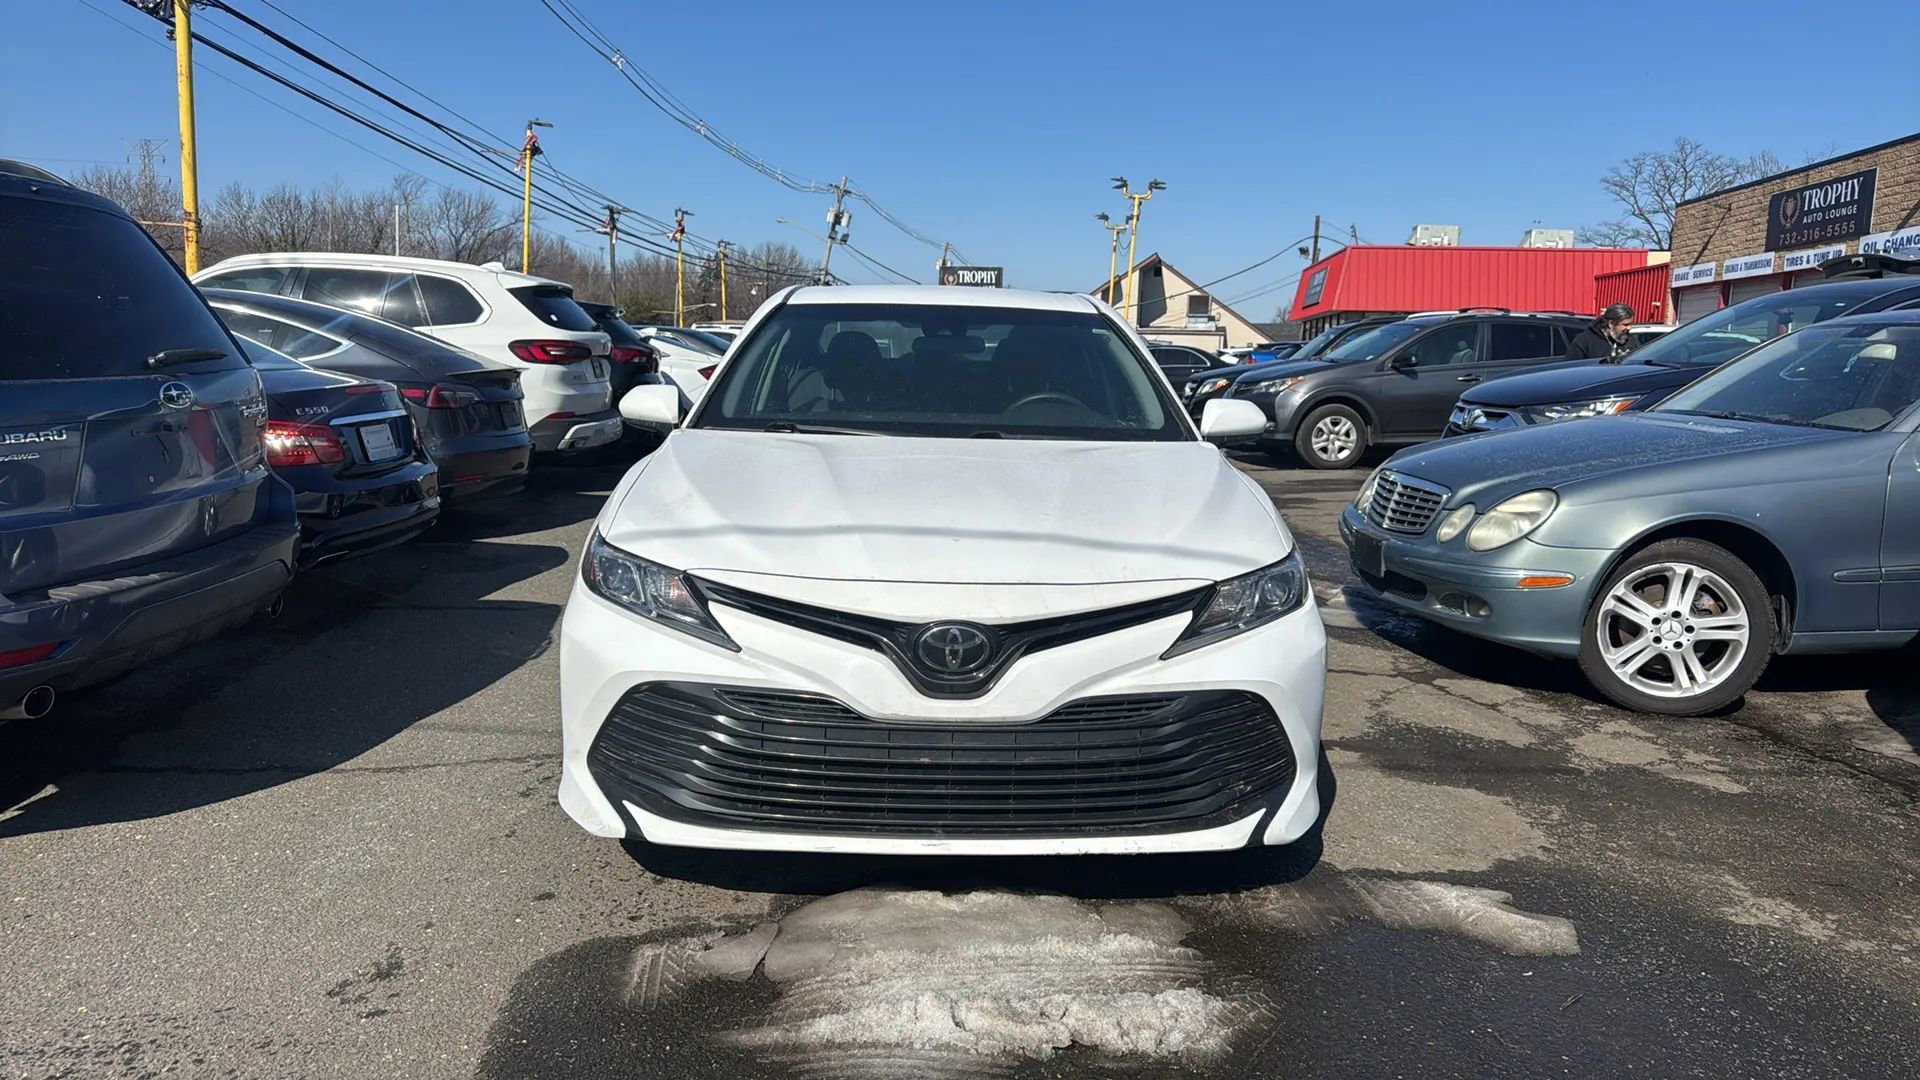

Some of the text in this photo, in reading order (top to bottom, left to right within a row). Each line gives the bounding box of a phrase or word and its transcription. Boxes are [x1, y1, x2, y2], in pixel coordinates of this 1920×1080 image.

[1803, 177, 1863, 211] TROPHY
[1803, 204, 1858, 225] AUTO LOUNGE
[1779, 220, 1856, 246] 732-316-5555
[1863, 241, 1879, 253] OIL
[1786, 255, 1804, 267] TIRES
[1814, 251, 1830, 263] TUNE
[957, 270, 997, 283] TROPHY
[1674, 267, 1713, 281] BRAKE SERVICE
[295, 406, 329, 415] E550
